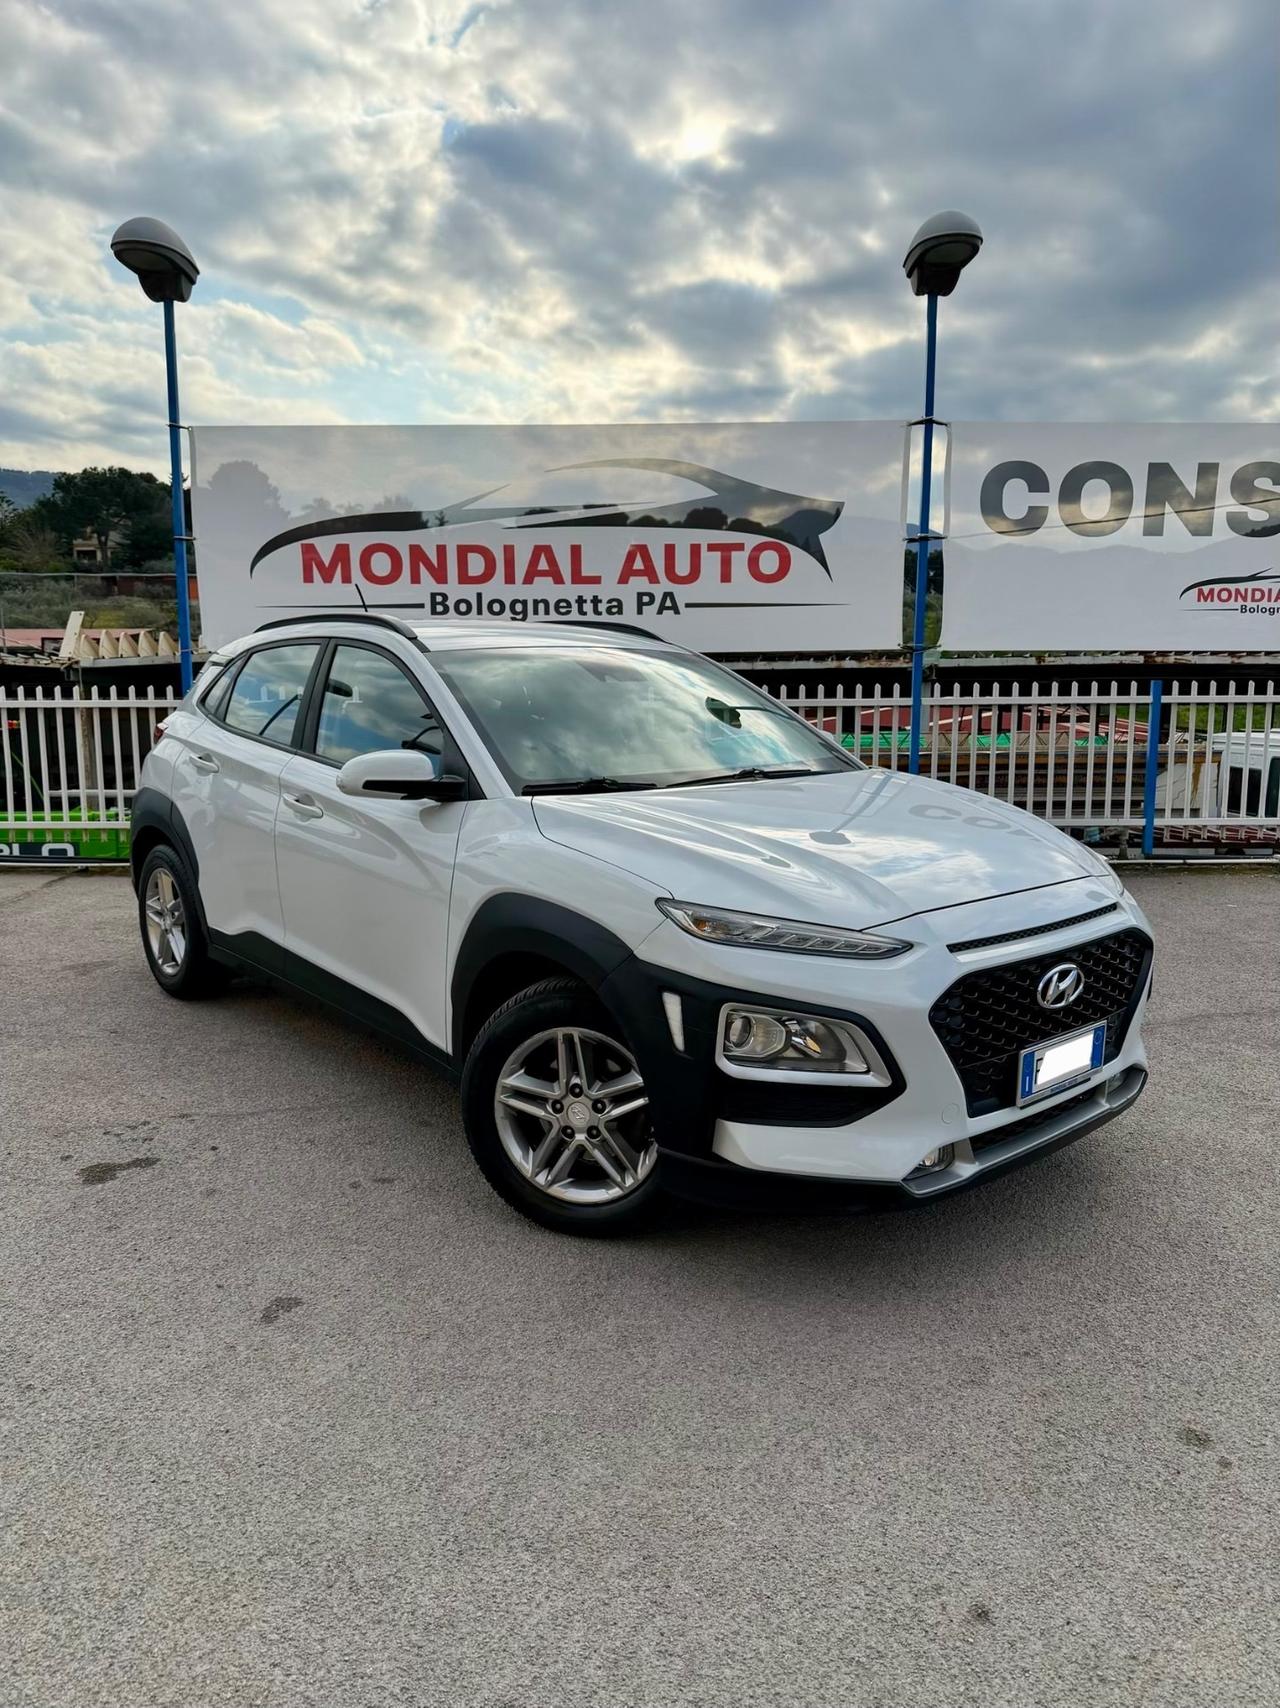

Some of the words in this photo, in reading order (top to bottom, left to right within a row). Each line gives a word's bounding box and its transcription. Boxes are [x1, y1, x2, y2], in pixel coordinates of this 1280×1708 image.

[979, 460, 1280, 538] CONS
[300, 543, 602, 585] MONDIAL
[617, 541, 792, 585] AUTO
[430, 591, 624, 622] Bolognetta
[636, 591, 681, 616] PA
